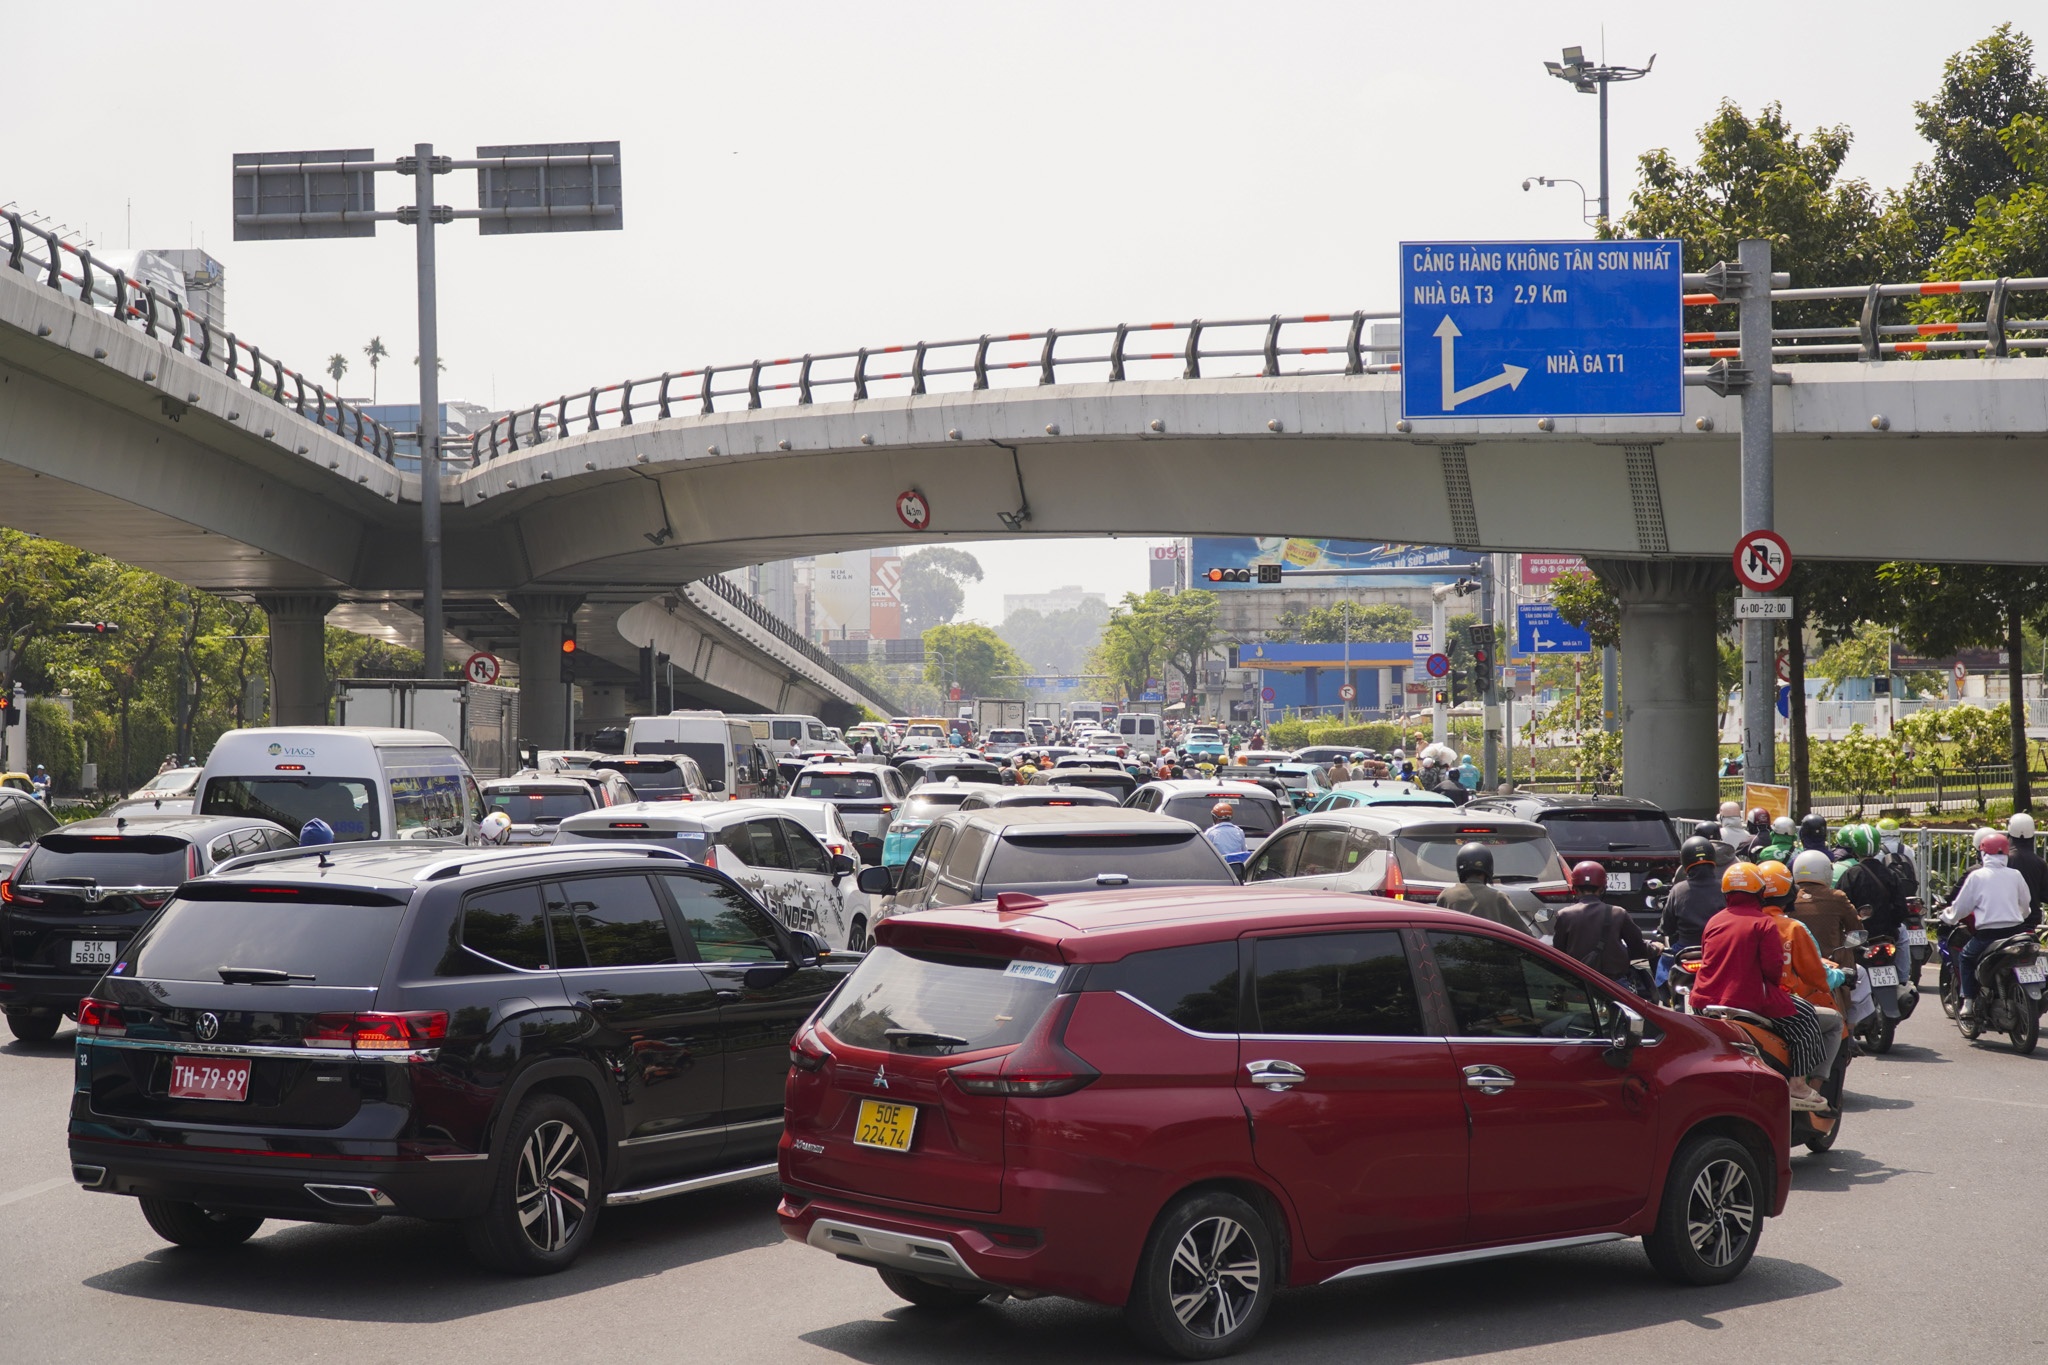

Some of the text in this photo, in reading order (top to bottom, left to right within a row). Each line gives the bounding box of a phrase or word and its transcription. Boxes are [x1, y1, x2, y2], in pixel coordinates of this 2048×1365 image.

[1413, 244, 1671, 272] CẢNG HÀNG KHÔNG TÂN SƠN NHẤT
[1414, 280, 1567, 305] NHÀ GA T3 2,9 Km
[1547, 349, 1624, 374] NHÀ GA T1
[284, 747, 316, 756] VIAGS
[76, 953, 110, 963] 569.09
[84, 942, 103, 952] 51K
[1010, 964, 1021, 973] XE
[80, 1054, 88, 1066] 32
[175, 1065, 247, 1091] TH-79-99
[875, 1102, 900, 1126] 50E
[862, 1124, 906, 1148] 224.74
